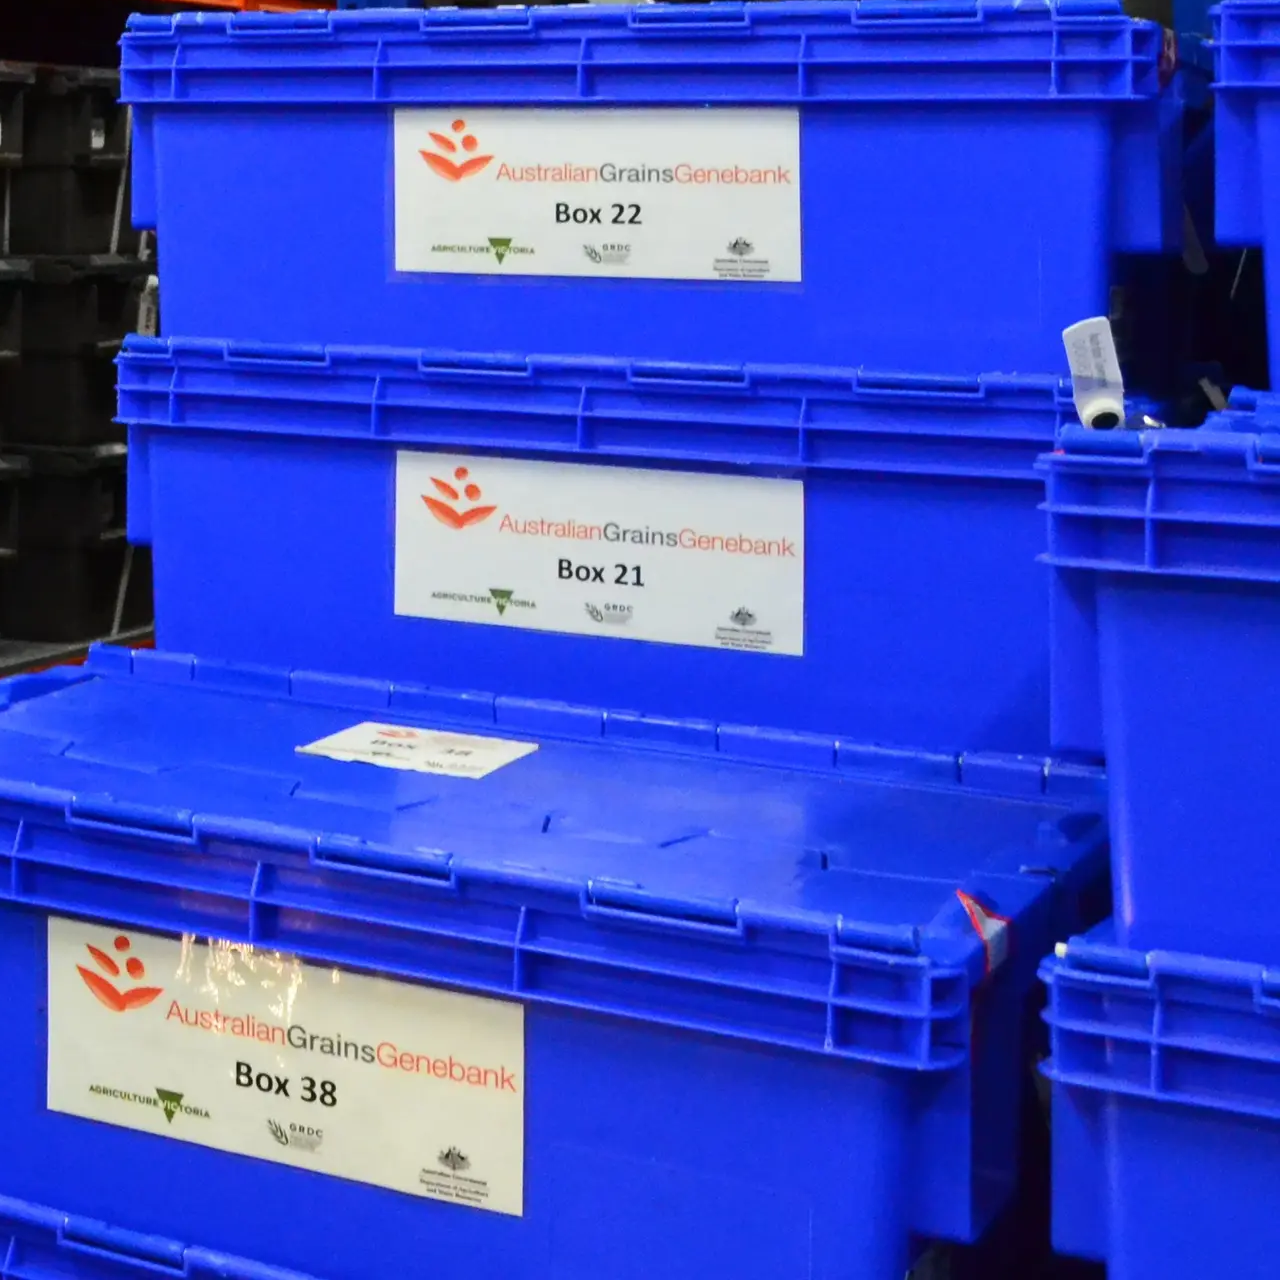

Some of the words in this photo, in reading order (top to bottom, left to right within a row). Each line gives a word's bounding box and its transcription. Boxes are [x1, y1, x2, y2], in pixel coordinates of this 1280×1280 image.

[496, 161, 791, 186] AustralianGrainsGenebank
[555, 201, 603, 226] Box
[610, 202, 643, 225] 22
[499, 513, 797, 559] AustralianGrainsGenebank
[557, 558, 605, 585] Box
[614, 563, 646, 588] 21
[166, 999, 518, 1093] AustralianGrainsGenebank
[89, 1083, 160, 1108] AGRICULTURE
[235, 1060, 290, 1099] Box
[300, 1075, 338, 1109] 38
[289, 1121, 324, 1138] GRDC
